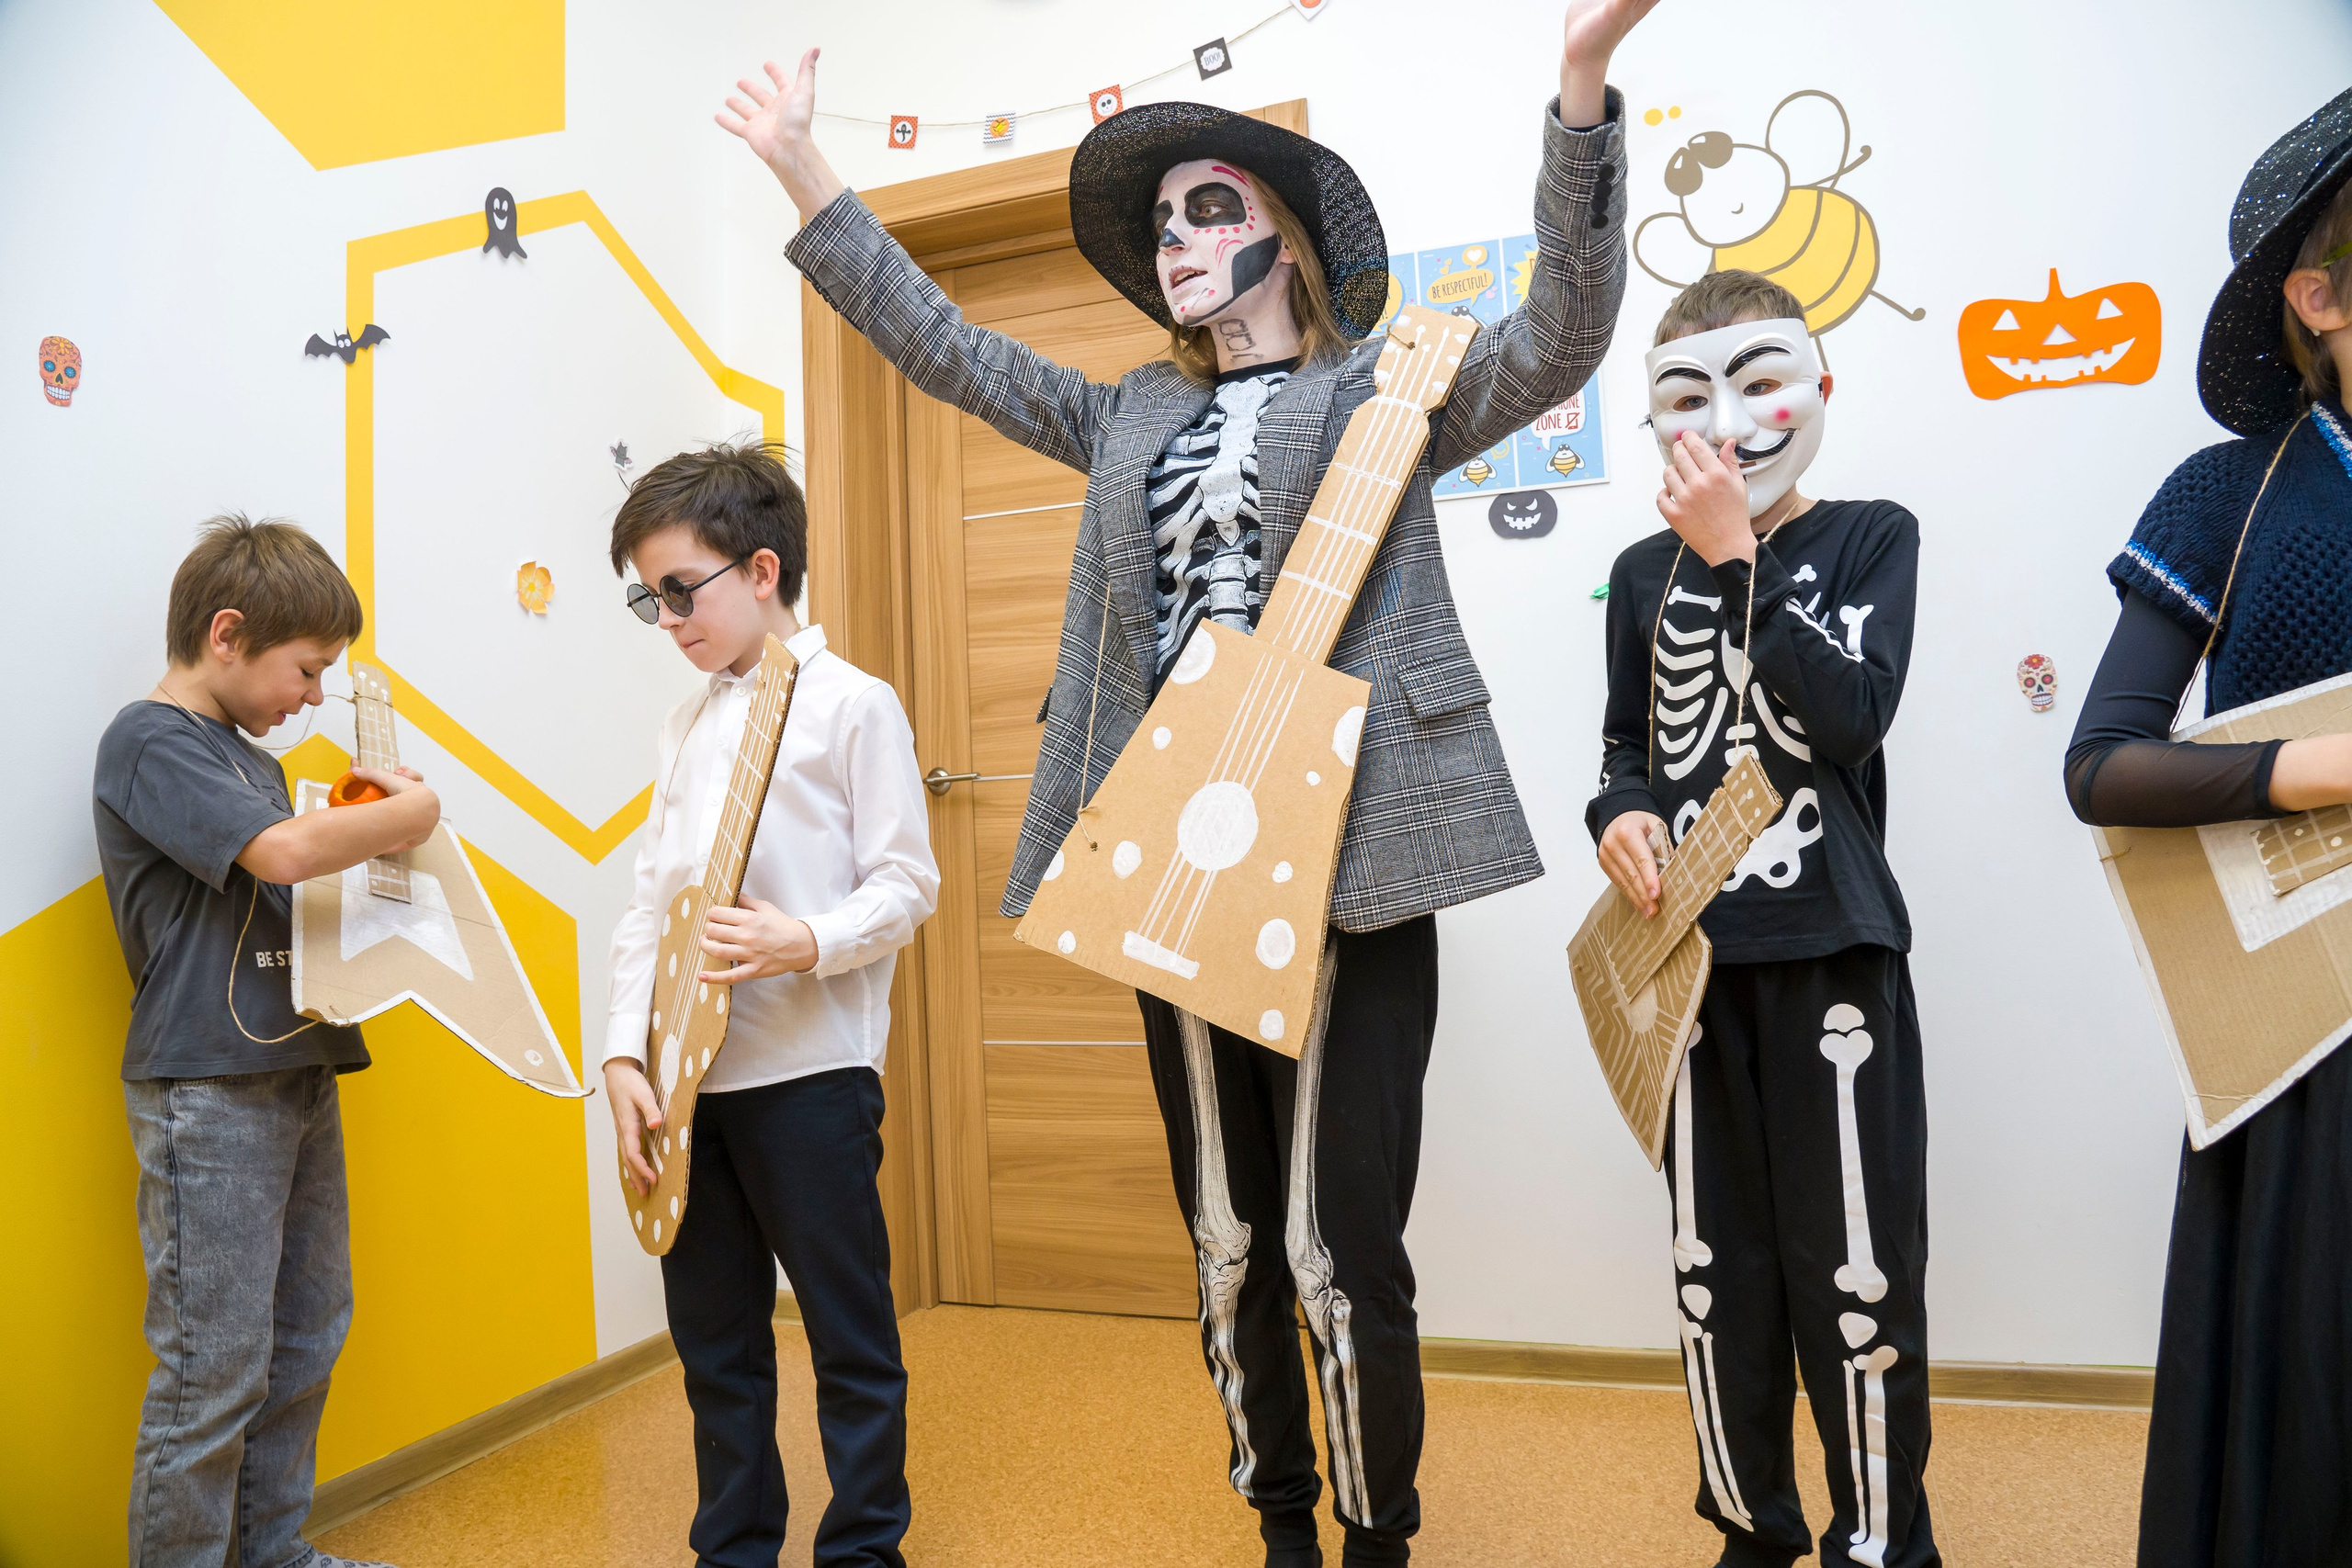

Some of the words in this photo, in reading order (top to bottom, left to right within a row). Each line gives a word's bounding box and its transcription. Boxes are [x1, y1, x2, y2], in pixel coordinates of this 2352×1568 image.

[1204, 51, 1222, 66] BOO!
[1431, 285, 1442, 299] BE
[1442, 272, 1488, 297] RESPECTFUL!
[1535, 412, 1563, 431] ZONE
[255, 951, 275, 968] BE
